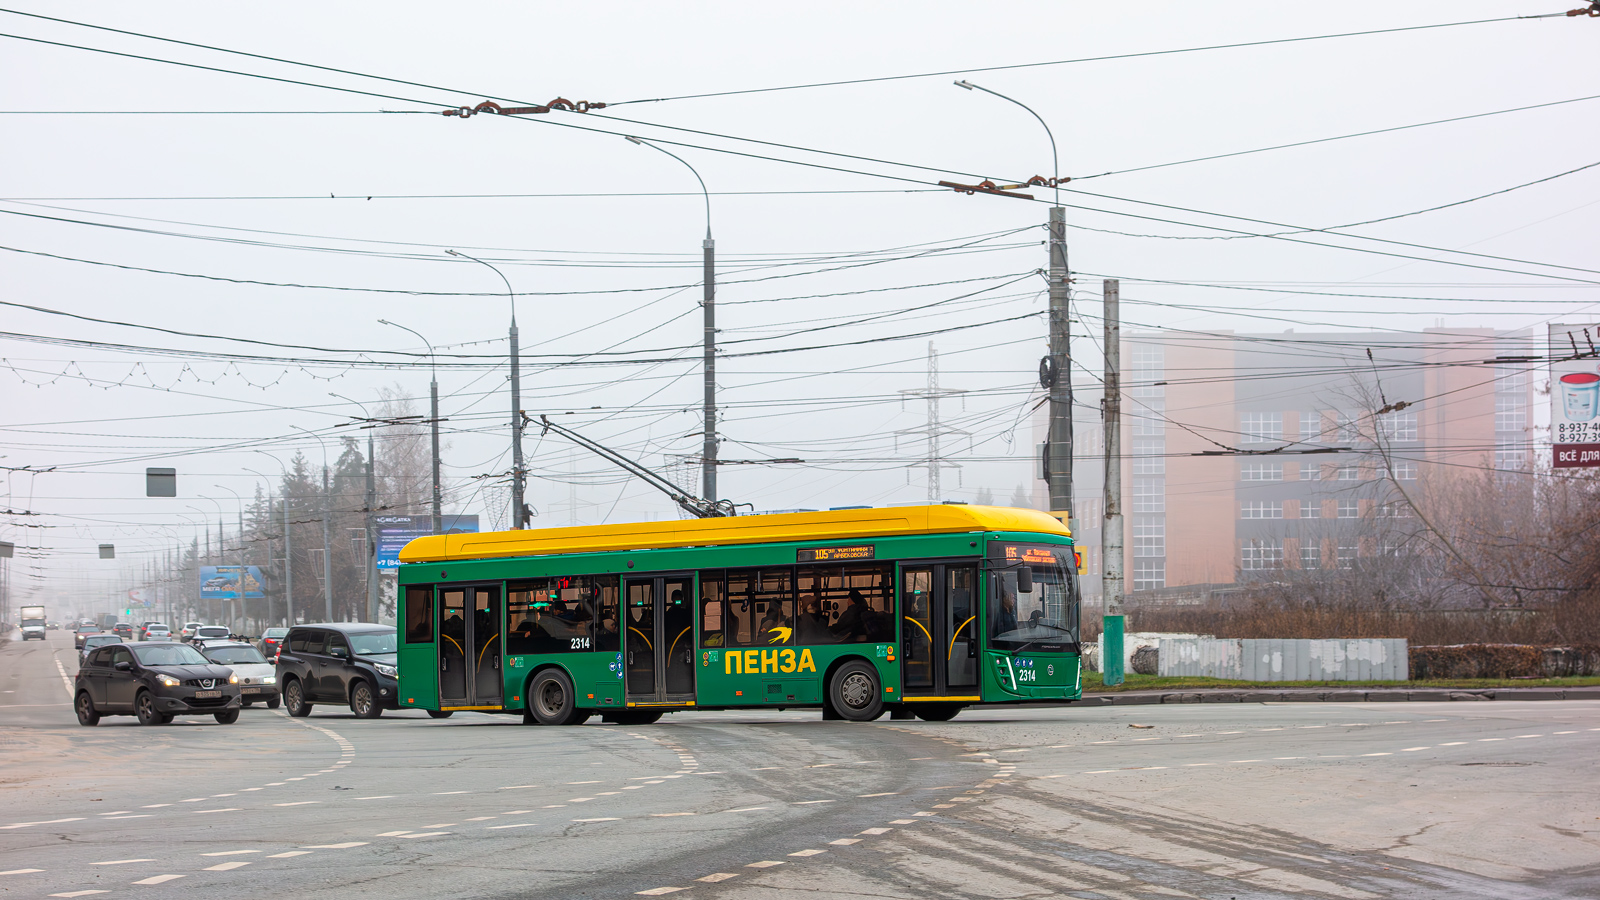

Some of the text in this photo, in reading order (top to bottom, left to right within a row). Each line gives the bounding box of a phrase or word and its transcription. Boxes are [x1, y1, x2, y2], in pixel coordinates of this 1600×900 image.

[1559, 422, 1600, 432] 8-937-4
[1559, 449, 1600, 462] ВСЁ ДЛЯ
[815, 549, 829, 560] 105
[1006, 546, 1017, 560] 105
[570, 638, 590, 650] 2314
[724, 648, 816, 674] ПЕНЗА
[1019, 669, 1036, 682] 2314
